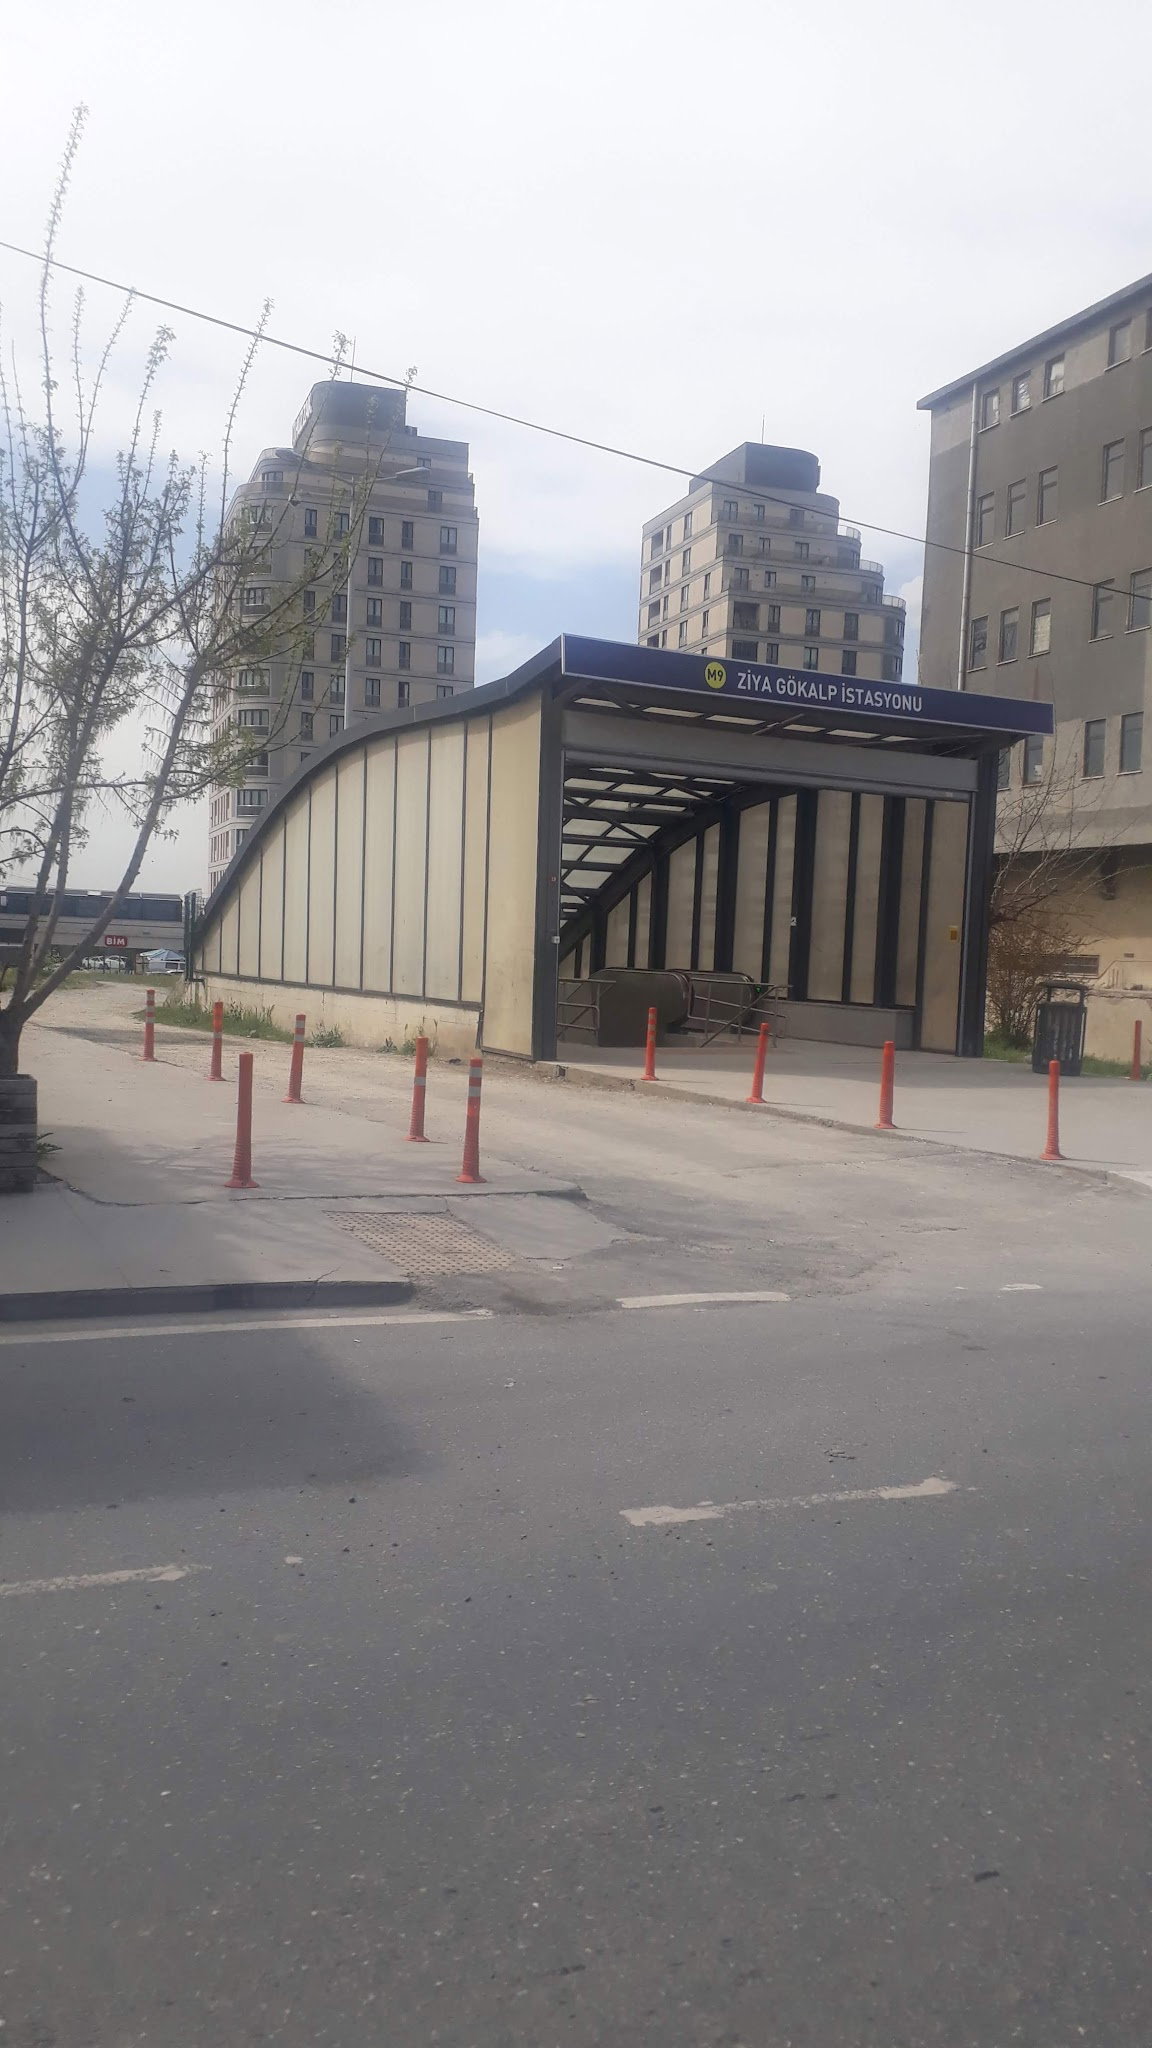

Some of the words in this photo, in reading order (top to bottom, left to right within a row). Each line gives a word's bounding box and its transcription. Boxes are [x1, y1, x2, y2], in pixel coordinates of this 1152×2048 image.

[706, 668, 724, 681] M9
[737, 669, 772, 693] ZİYA
[776, 676, 838, 701] GÖKALP
[841, 682, 922, 712] İSTASYONU
